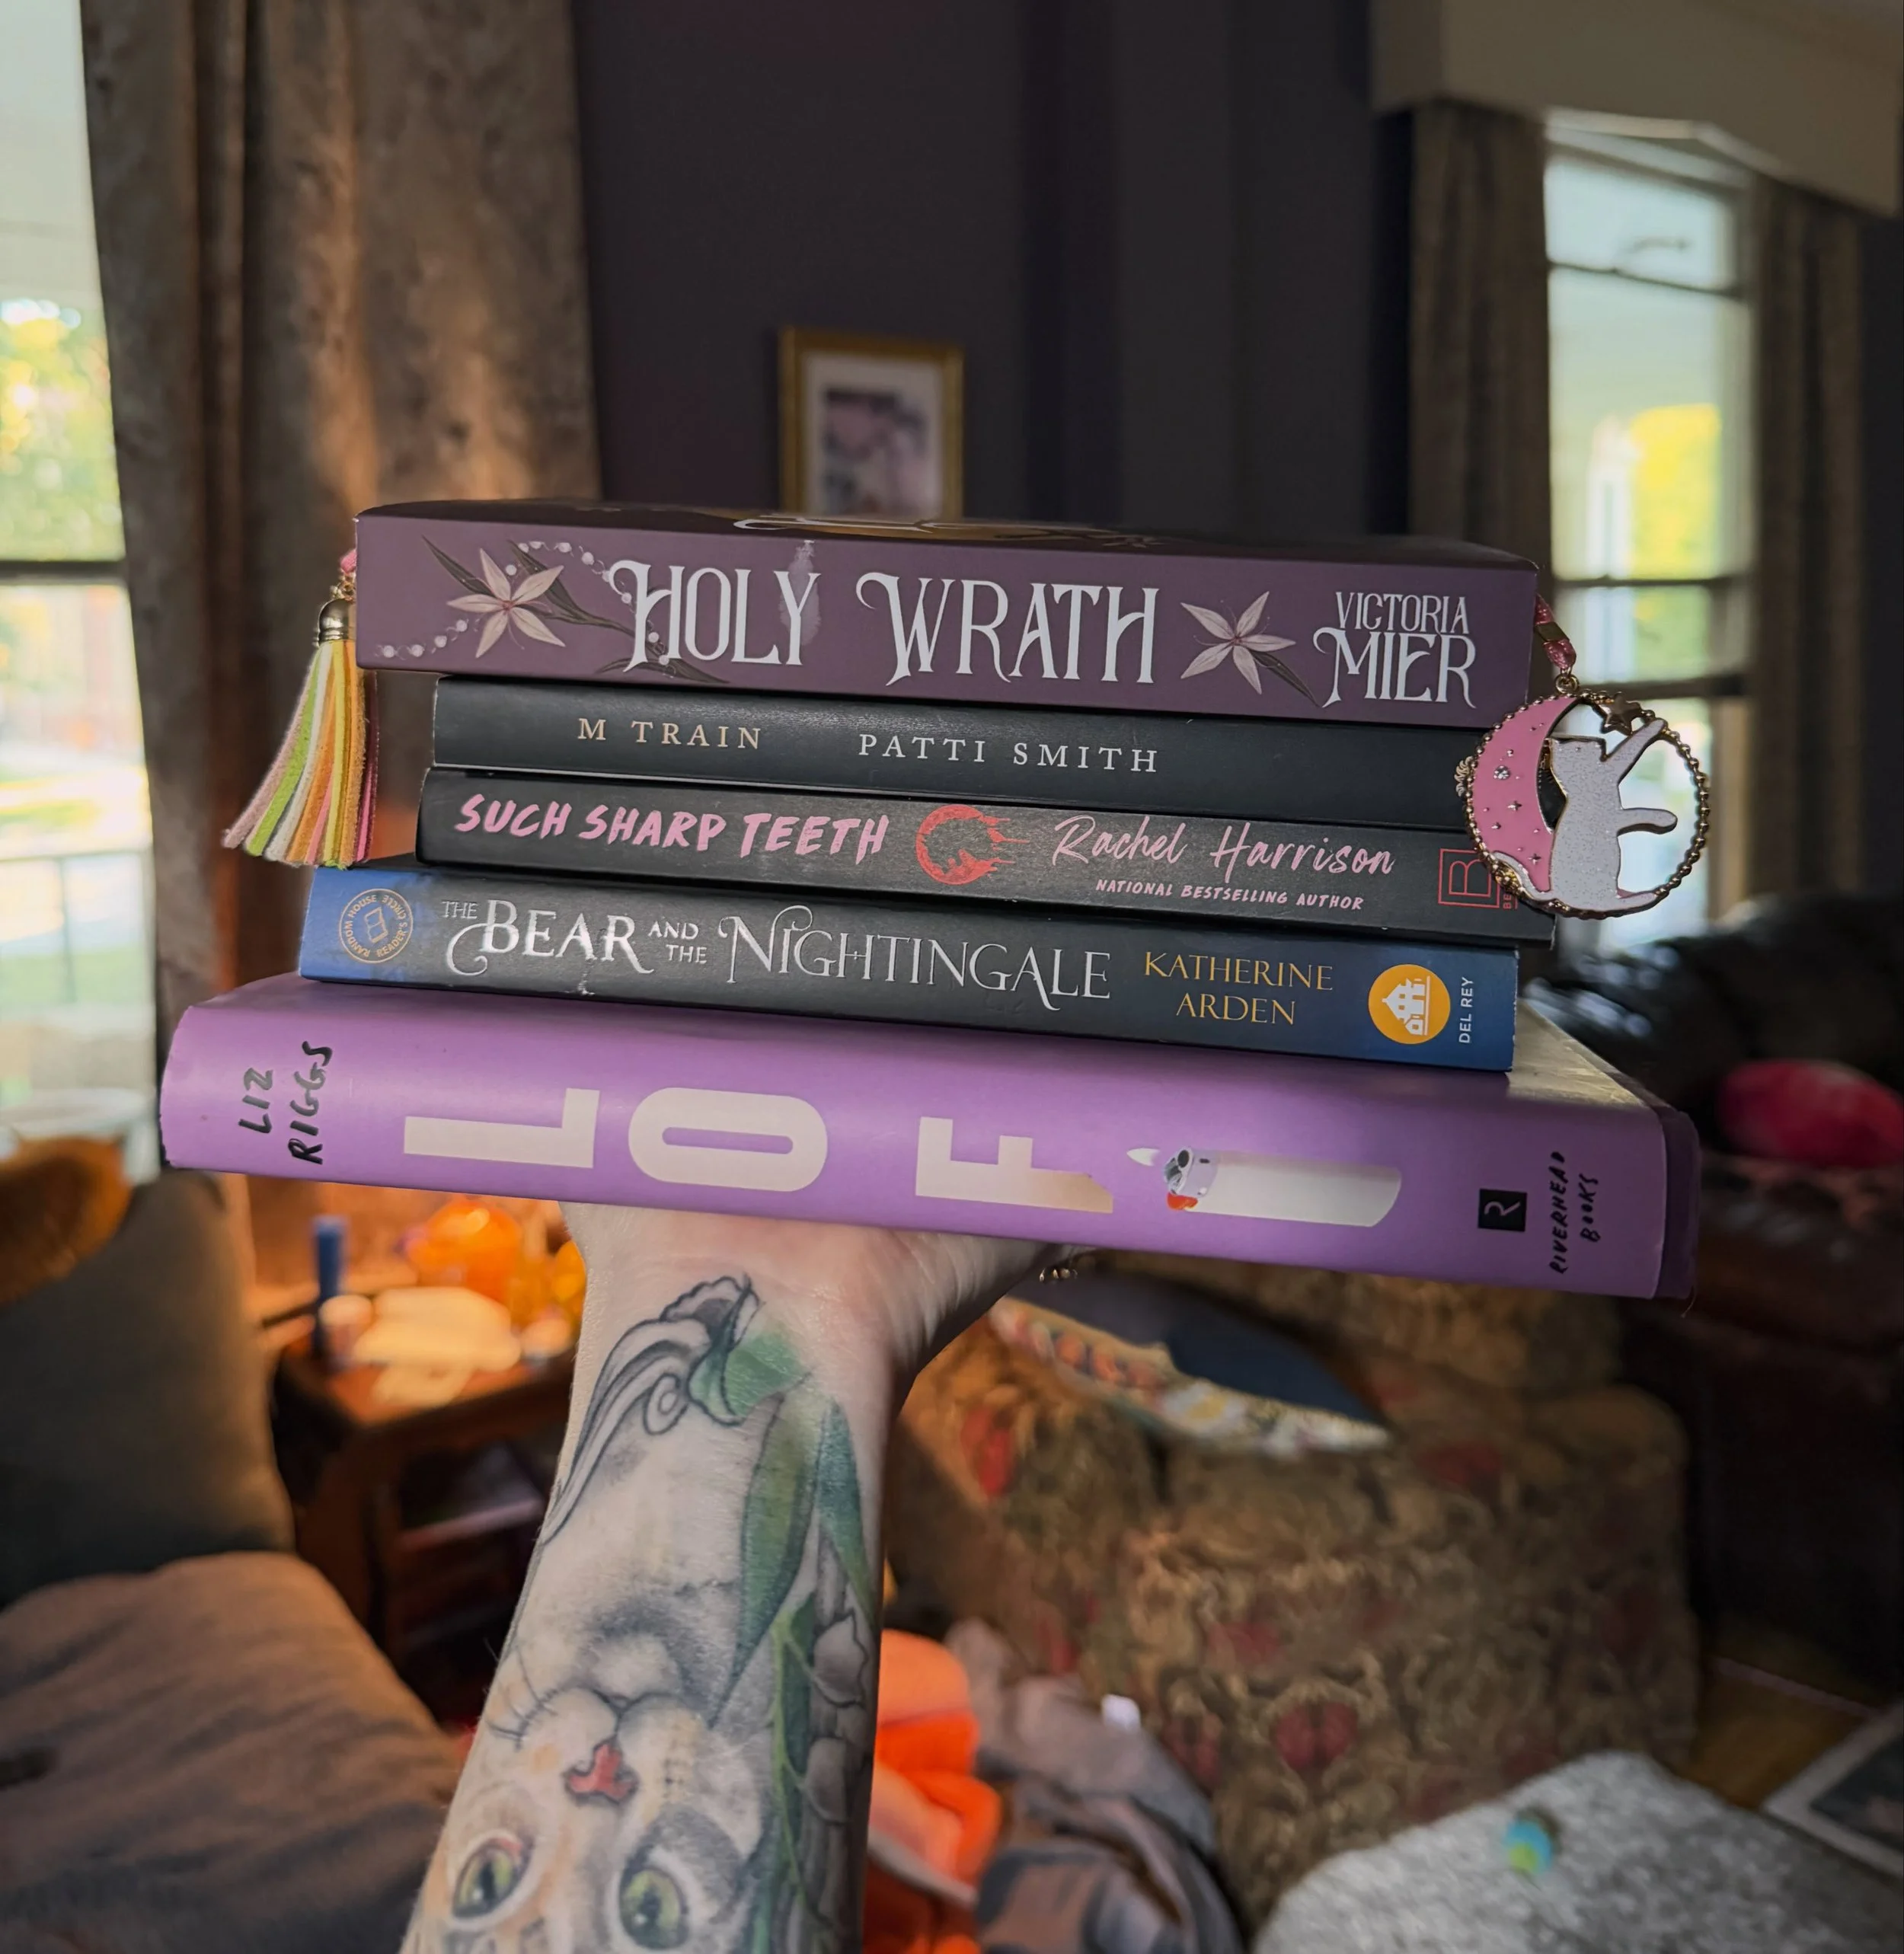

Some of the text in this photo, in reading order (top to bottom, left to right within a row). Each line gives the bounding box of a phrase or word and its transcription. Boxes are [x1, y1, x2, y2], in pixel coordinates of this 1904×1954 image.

[609, 559, 1160, 687] HOLY WRATH
[1336, 591, 1471, 634] VICTORIA
[1313, 626, 1478, 710] MIER
[577, 717, 761, 751] M TRAIN
[858, 733, 1159, 774] PATTI SMITH
[455, 793, 890, 866] SUCH SHARP TEETH
[1051, 815, 1396, 883] Rachel Harrison
[1095, 879, 1366, 912] NATIONAL BESTSELLING AUTHOR
[441, 899, 655, 976] THE BEAR
[647, 921, 700, 941] AND
[665, 943, 708, 965] THE
[717, 905, 1111, 1011] NIGHTINGALE
[1143, 951, 1334, 991] KATHERINE
[1176, 992, 1295, 1026] ARDEN
[1458, 977, 1474, 1044] DEL REY
[238, 1067, 273, 1134] LIZ
[287, 1040, 333, 1165] RIGGS
[1548, 1151, 1569, 1275] RIVERHEAD
[1579, 1173, 1602, 1243] BOOKS
